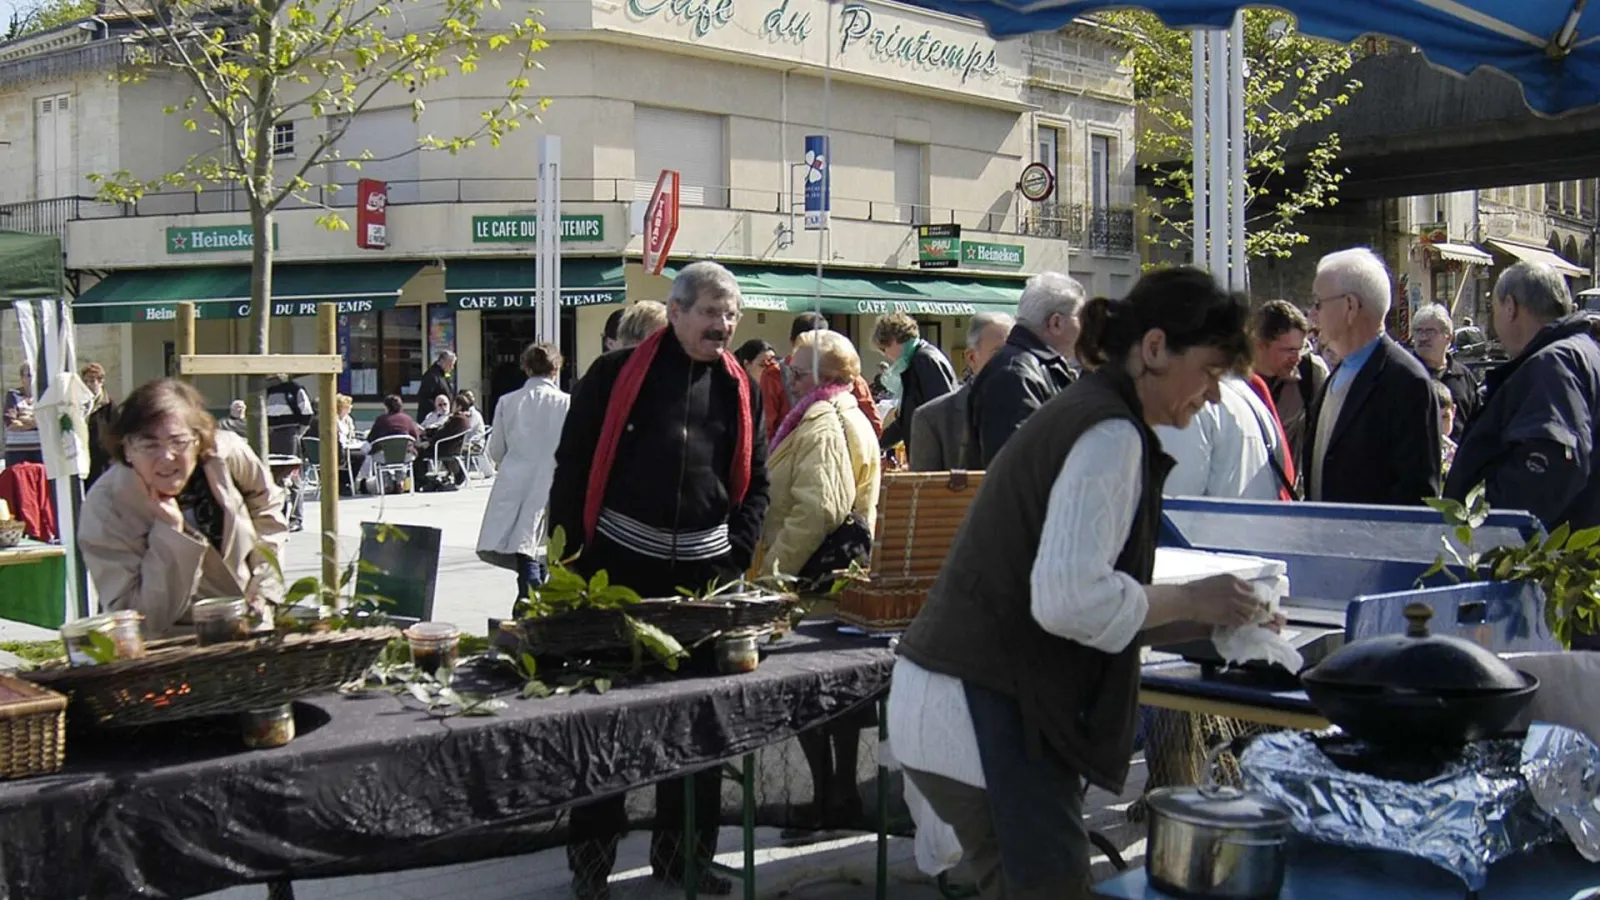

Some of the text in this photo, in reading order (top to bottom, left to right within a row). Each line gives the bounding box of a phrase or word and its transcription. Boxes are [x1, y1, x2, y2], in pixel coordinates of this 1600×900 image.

[765, 0, 811, 40] du
[841, 5, 998, 84] Printemps
[477, 220, 600, 237] LE CAFE DU NTEMPS
[191, 229, 260, 248] Heineke
[977, 245, 1021, 262] Heineken
[275, 303, 294, 315] DU
[300, 300, 373, 314] PREMPS
[460, 297, 497, 308] CAFE
[503, 296, 523, 307] DU
[858, 301, 888, 313] CAFE
[917, 302, 976, 315] PRINTEMPS
